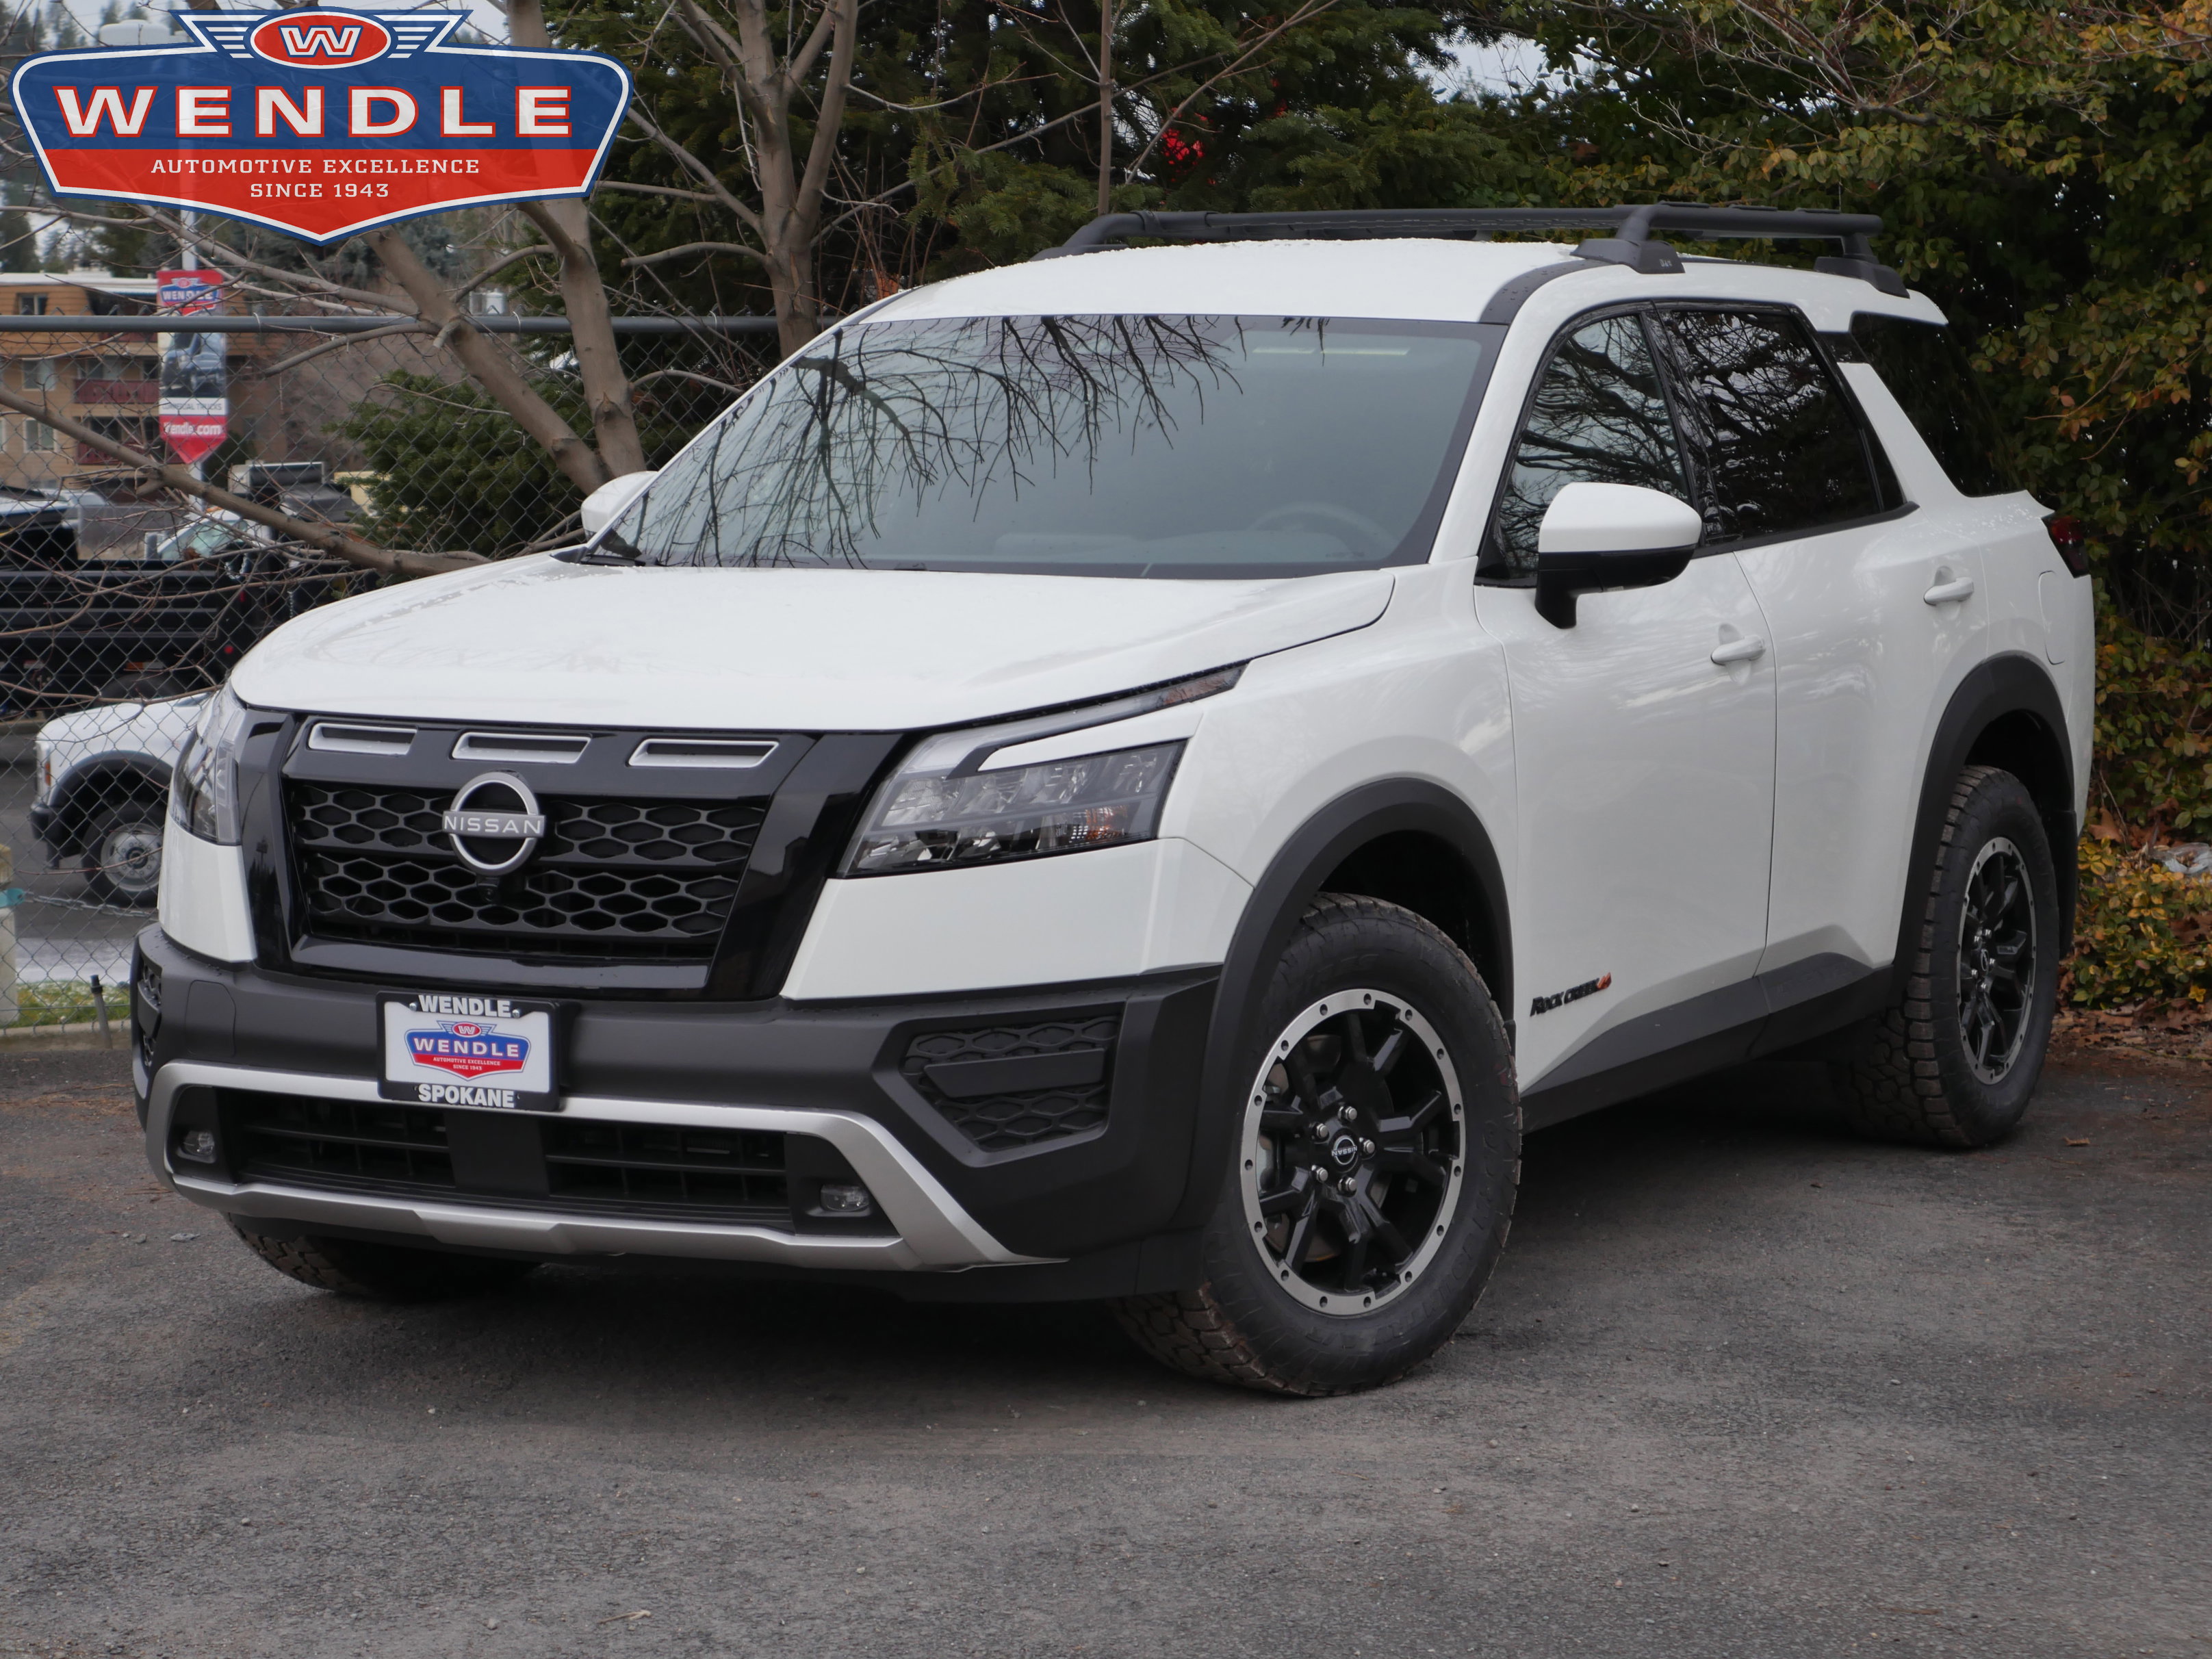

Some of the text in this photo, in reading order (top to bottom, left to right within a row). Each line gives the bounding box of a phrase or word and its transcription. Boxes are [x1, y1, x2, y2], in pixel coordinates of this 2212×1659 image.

[444, 815, 541, 834] NISSAN
[418, 994, 512, 1018] WENDLE
[413, 1038, 519, 1057] WENDLE
[418, 1083, 515, 1108] SPOKANE
[1331, 1145, 1358, 1157] NISSAN
